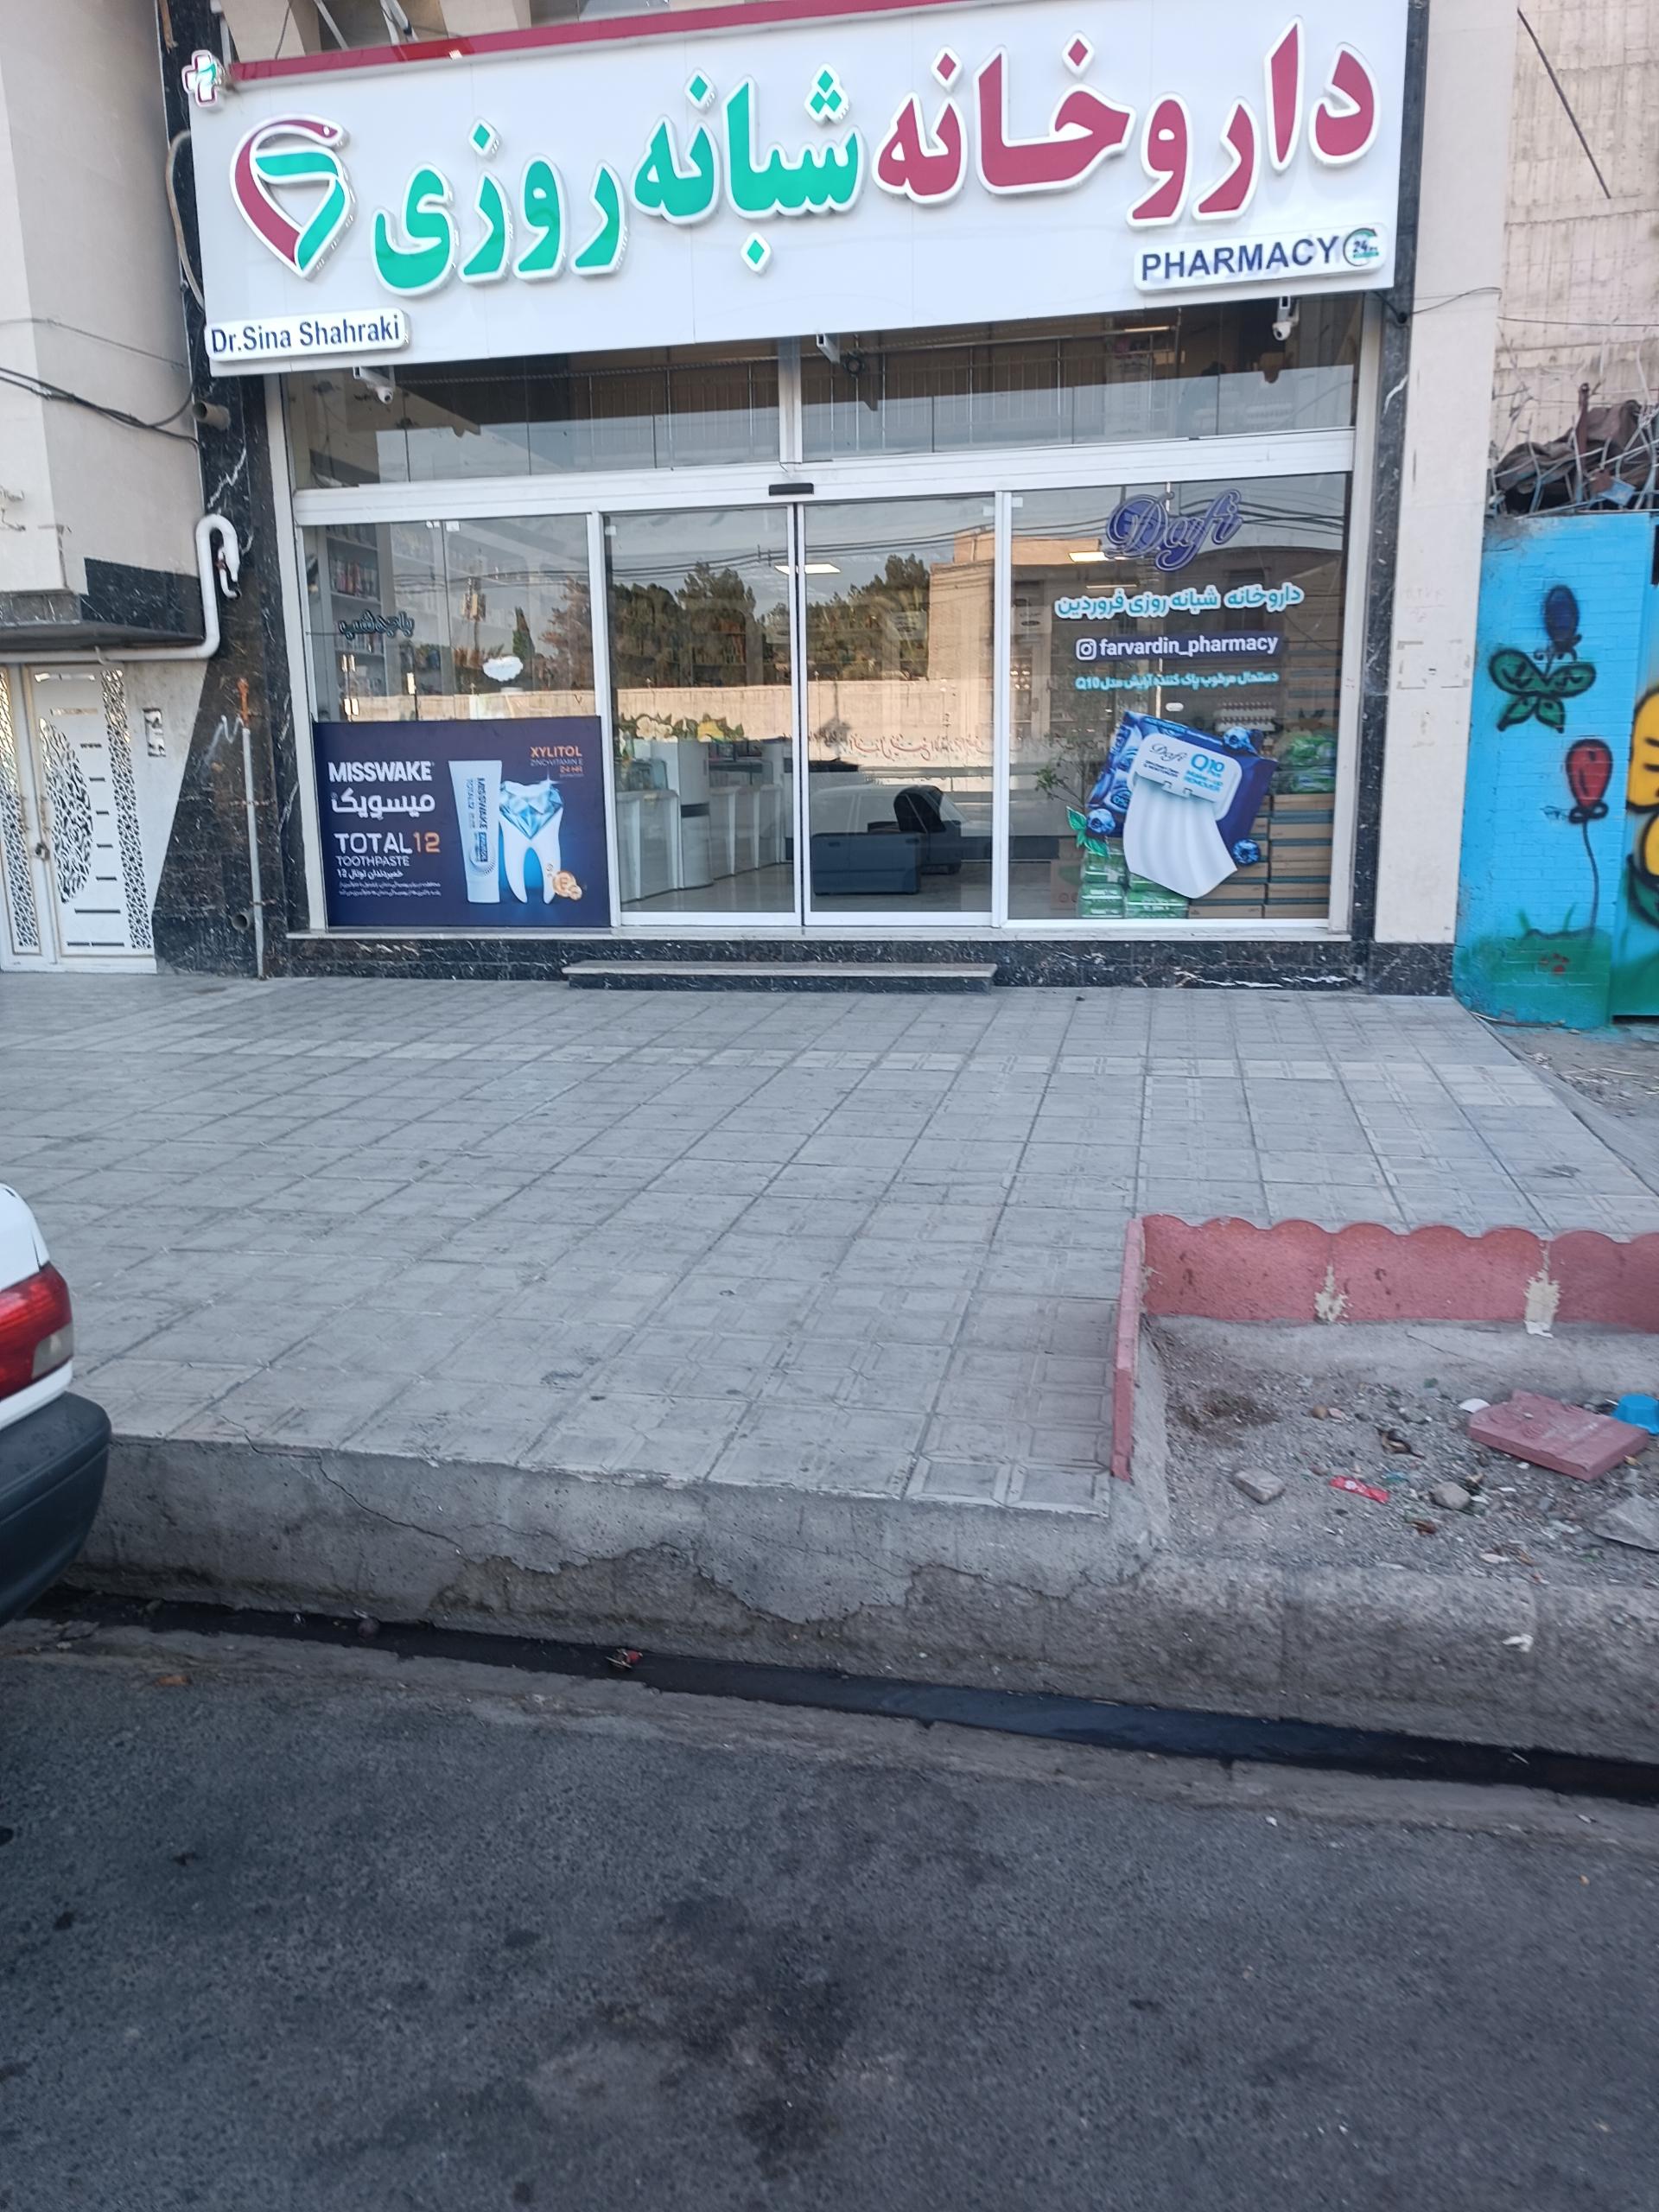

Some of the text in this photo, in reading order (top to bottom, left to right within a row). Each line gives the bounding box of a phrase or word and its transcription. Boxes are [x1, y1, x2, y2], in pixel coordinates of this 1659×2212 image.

[372, 19, 1377, 293] داروخانه شبانه روزی
[1141, 235, 1339, 281] PHARMACY
[211, 314, 400, 353] Dr.Sina Shahraki
[1056, 583, 1303, 618] داروخانه شبانه روزی فروردین
[1099, 634, 1279, 658] farvardin_pharmacy
[530, 746, 582, 758] XYLITOL
[1190, 753, 1225, 772] Q10
[328, 760, 433, 782] MISSWAKE
[334, 832, 441, 854] TOTAL 12
[335, 855, 410, 867] TOOTHPASTE
